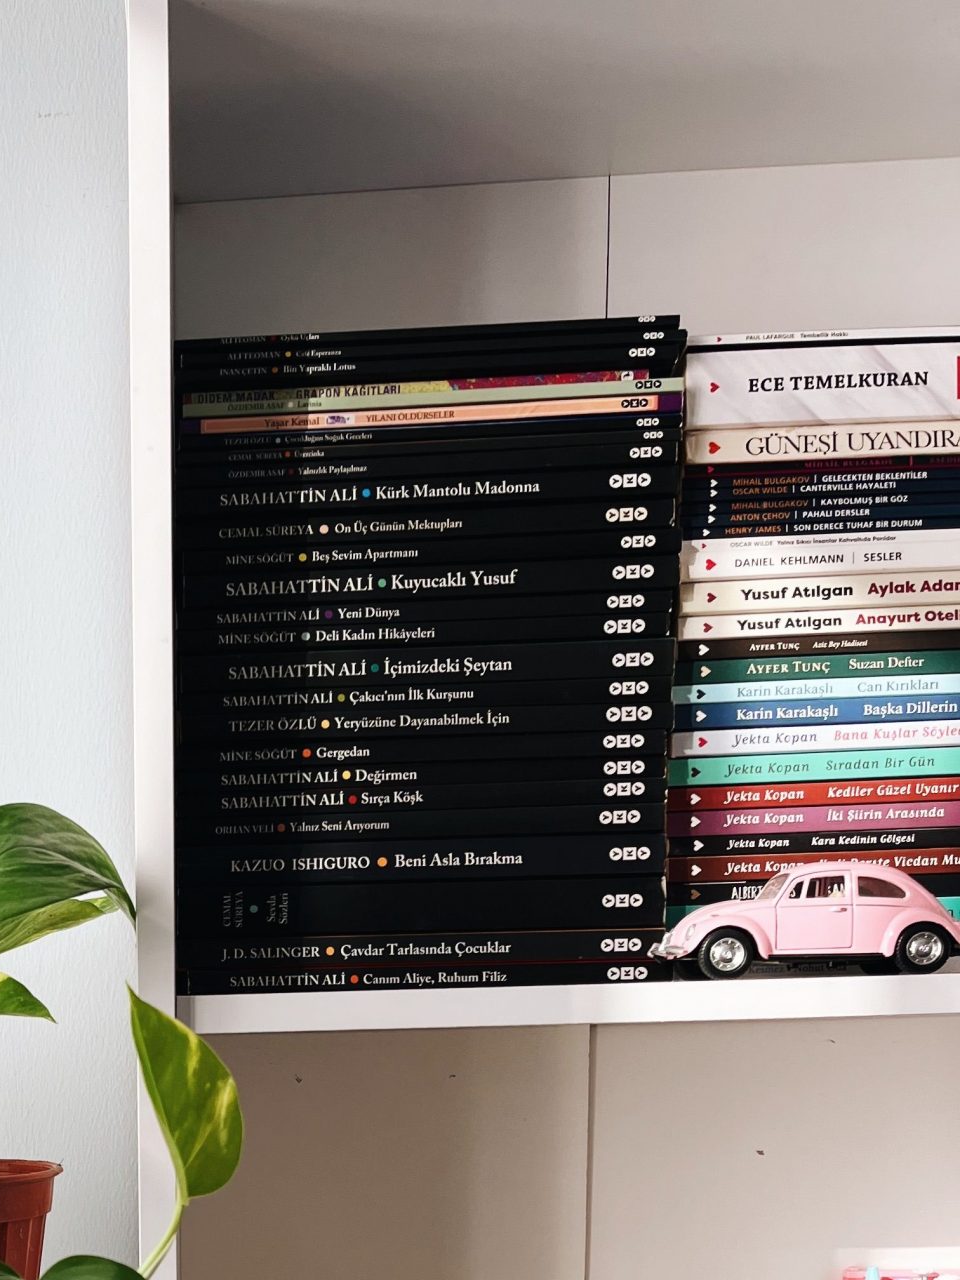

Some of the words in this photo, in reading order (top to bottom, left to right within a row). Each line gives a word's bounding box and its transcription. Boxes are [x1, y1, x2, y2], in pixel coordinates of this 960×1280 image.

[749, 378, 784, 392] ECE
[790, 372, 928, 391] TEMELKURAN
[746, 432, 838, 456] GÜNEŞİ
[822, 472, 873, 482] GELECEKTEN
[875, 471, 927, 480] BEKLENTİLER
[220, 487, 326, 507] SABAHATTİN
[329, 487, 357, 503] ALİ
[376, 486, 410, 500] Kürk
[413, 483, 471, 498] Mantolu
[476, 480, 540, 495] Madonna
[726, 526, 751, 534] HENRY
[755, 525, 781, 534] JAMES
[794, 524, 811, 532] SON
[813, 522, 844, 530] DERECE
[846, 521, 874, 530] TUHAF
[876, 520, 888, 528] BİR
[890, 519, 922, 528] DURUM
[735, 558, 774, 568] DANIEL
[781, 554, 844, 566] KEHLMANN
[864, 552, 902, 562] SESLER
[226, 576, 340, 598] SABAHATTİN
[344, 573, 374, 593] ALİ
[392, 572, 466, 591] Kuyucaklı
[470, 568, 518, 589] Yusuf
[741, 588, 788, 601] Yusuf
[792, 586, 853, 600] Atılgan
[868, 580, 916, 595] Aylak
[316, 628, 339, 642] Deli
[341, 627, 374, 642] Kadın
[378, 626, 435, 641] Hikâyeleri
[229, 661, 336, 681] SABAHATTİN
[339, 659, 367, 677] ALİ
[384, 657, 460, 678] İçimizdeki
[464, 656, 512, 675] Şeytan
[747, 662, 788, 674] AYFER
[792, 661, 830, 674] TUNÇ
[849, 658, 884, 670] Suzan
[888, 658, 924, 668] Defter
[737, 709, 772, 720] Karin
[777, 706, 838, 720] Karakaşlı
[864, 704, 902, 717] Başka
[907, 701, 958, 714] Dillerin
[229, 718, 275, 733] TEZER
[278, 713, 317, 731] ÖZLÜ
[335, 713, 395, 730] Yeryüzüne
[399, 712, 484, 729] Dayanabilmek
[487, 710, 510, 727] İçin
[724, 814, 760, 828] Yekta
[764, 812, 804, 825] Kopan
[827, 810, 843, 822] İki
[848, 809, 882, 822] Şiirin
[886, 808, 944, 820] Arasında
[231, 856, 285, 873] KAZUO
[292, 854, 370, 871] ISHIGURO
[394, 853, 426, 869] Beni
[430, 852, 460, 867] Asla
[465, 850, 522, 866] Bırakma
[222, 946, 230, 962] J.
[233, 946, 247, 960] D.
[250, 943, 320, 960] SALINGER
[341, 942, 384, 960] Çavdar
[388, 940, 452, 956] Tarlasında
[455, 939, 511, 956] Çocuklar
